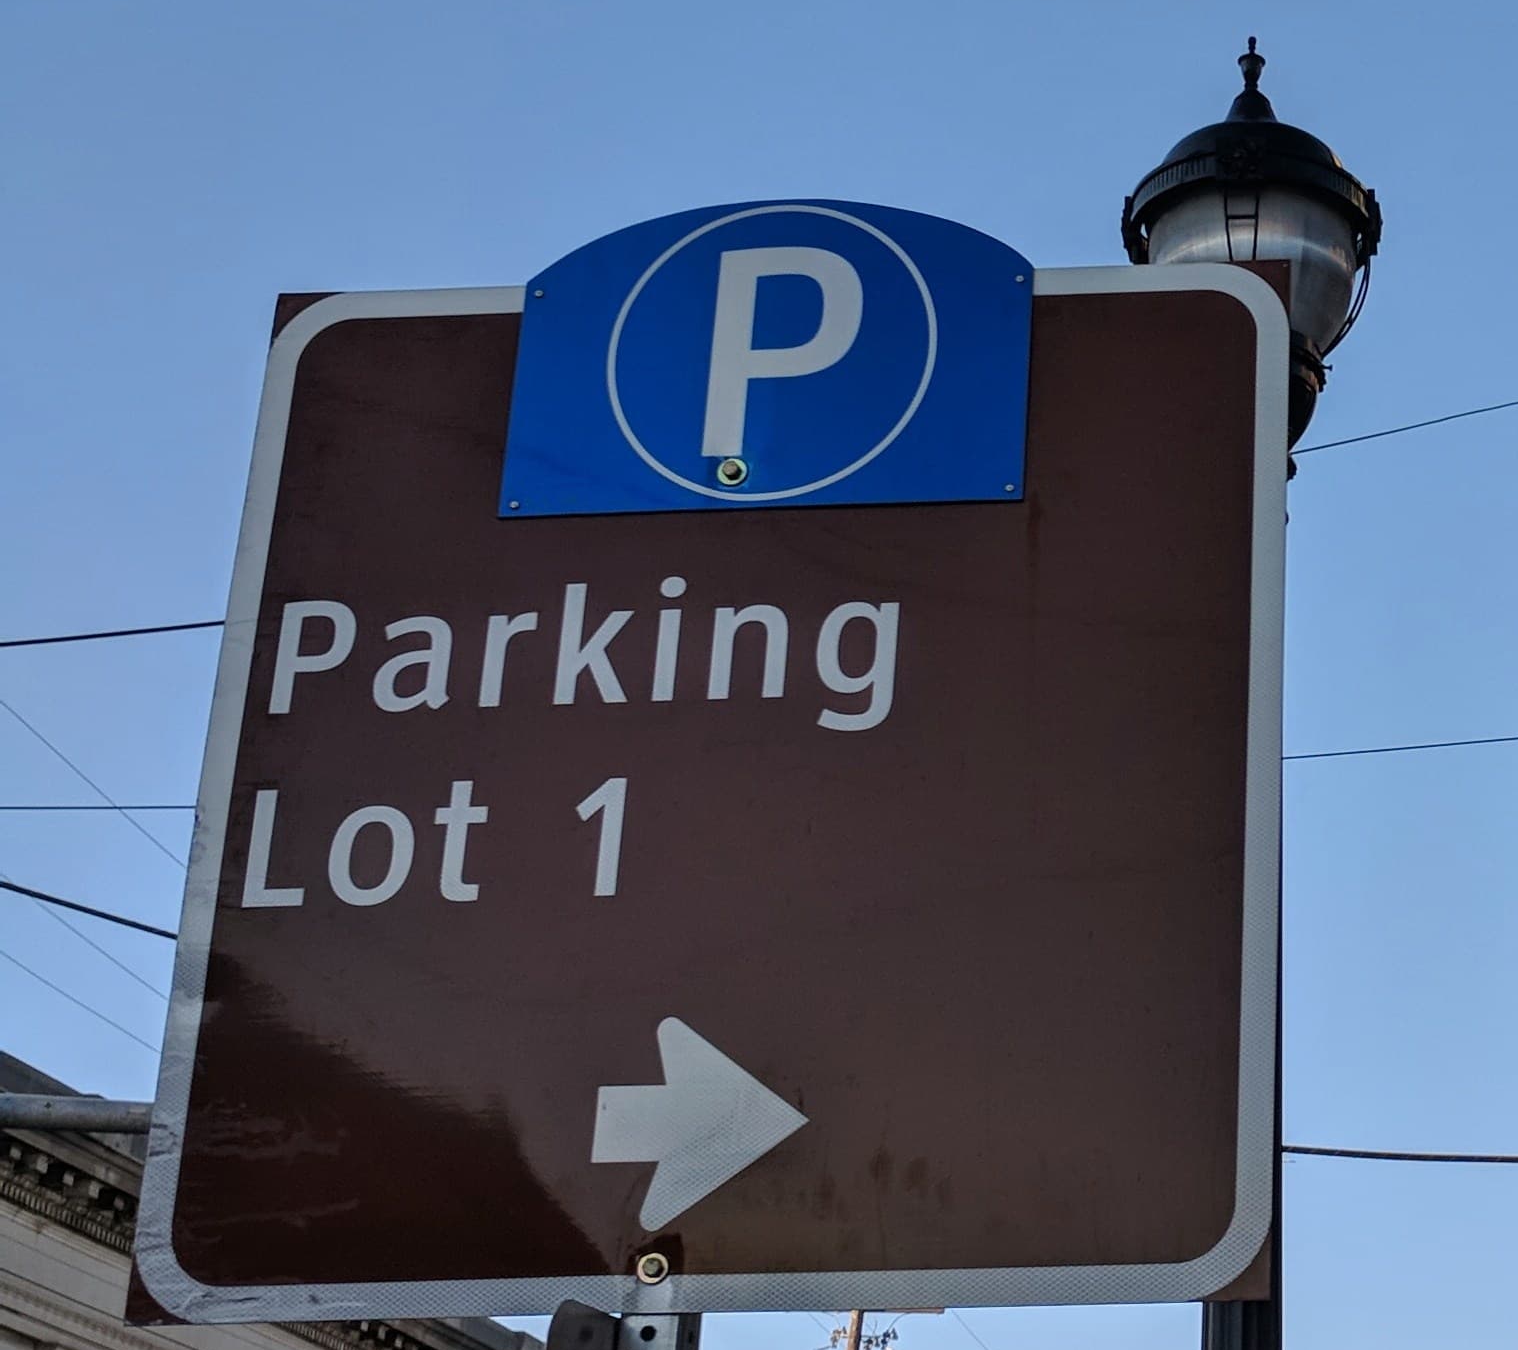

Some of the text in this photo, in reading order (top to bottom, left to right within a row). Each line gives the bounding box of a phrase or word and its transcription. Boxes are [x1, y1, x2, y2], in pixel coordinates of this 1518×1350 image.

[703, 247, 864, 457] P
[267, 577, 900, 731] Parking
[242, 778, 627, 907] Lot 1
